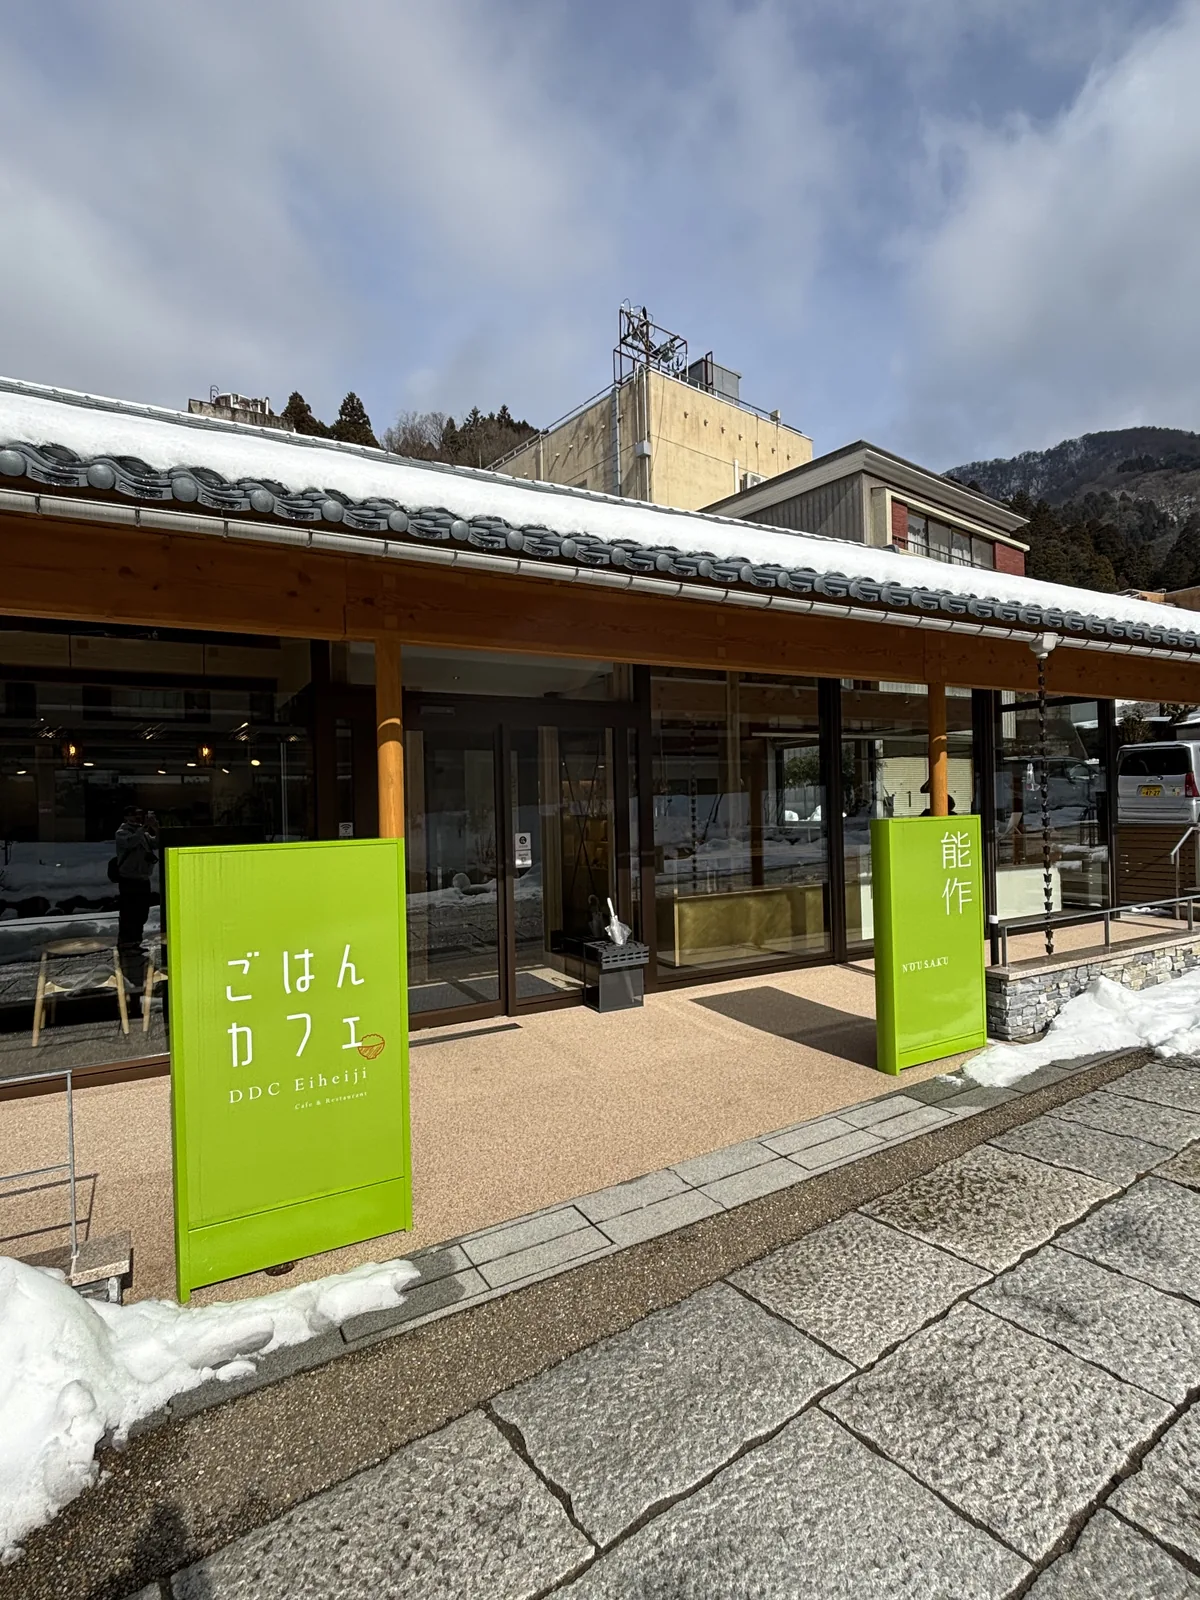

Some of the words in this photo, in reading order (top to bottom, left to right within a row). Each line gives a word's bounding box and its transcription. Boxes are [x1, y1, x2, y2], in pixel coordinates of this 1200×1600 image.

[940, 831, 974, 916] 能作
[226, 944, 366, 1002] ごはん
[902, 956, 949, 974] NOUSAKU
[227, 1012, 364, 1069] カフェ
[229, 1082, 281, 1104] DDC
[294, 1066, 368, 1092] Eiheiji
[294, 1101, 313, 1110] Cafe
[325, 1091, 368, 1104] Restaurant
